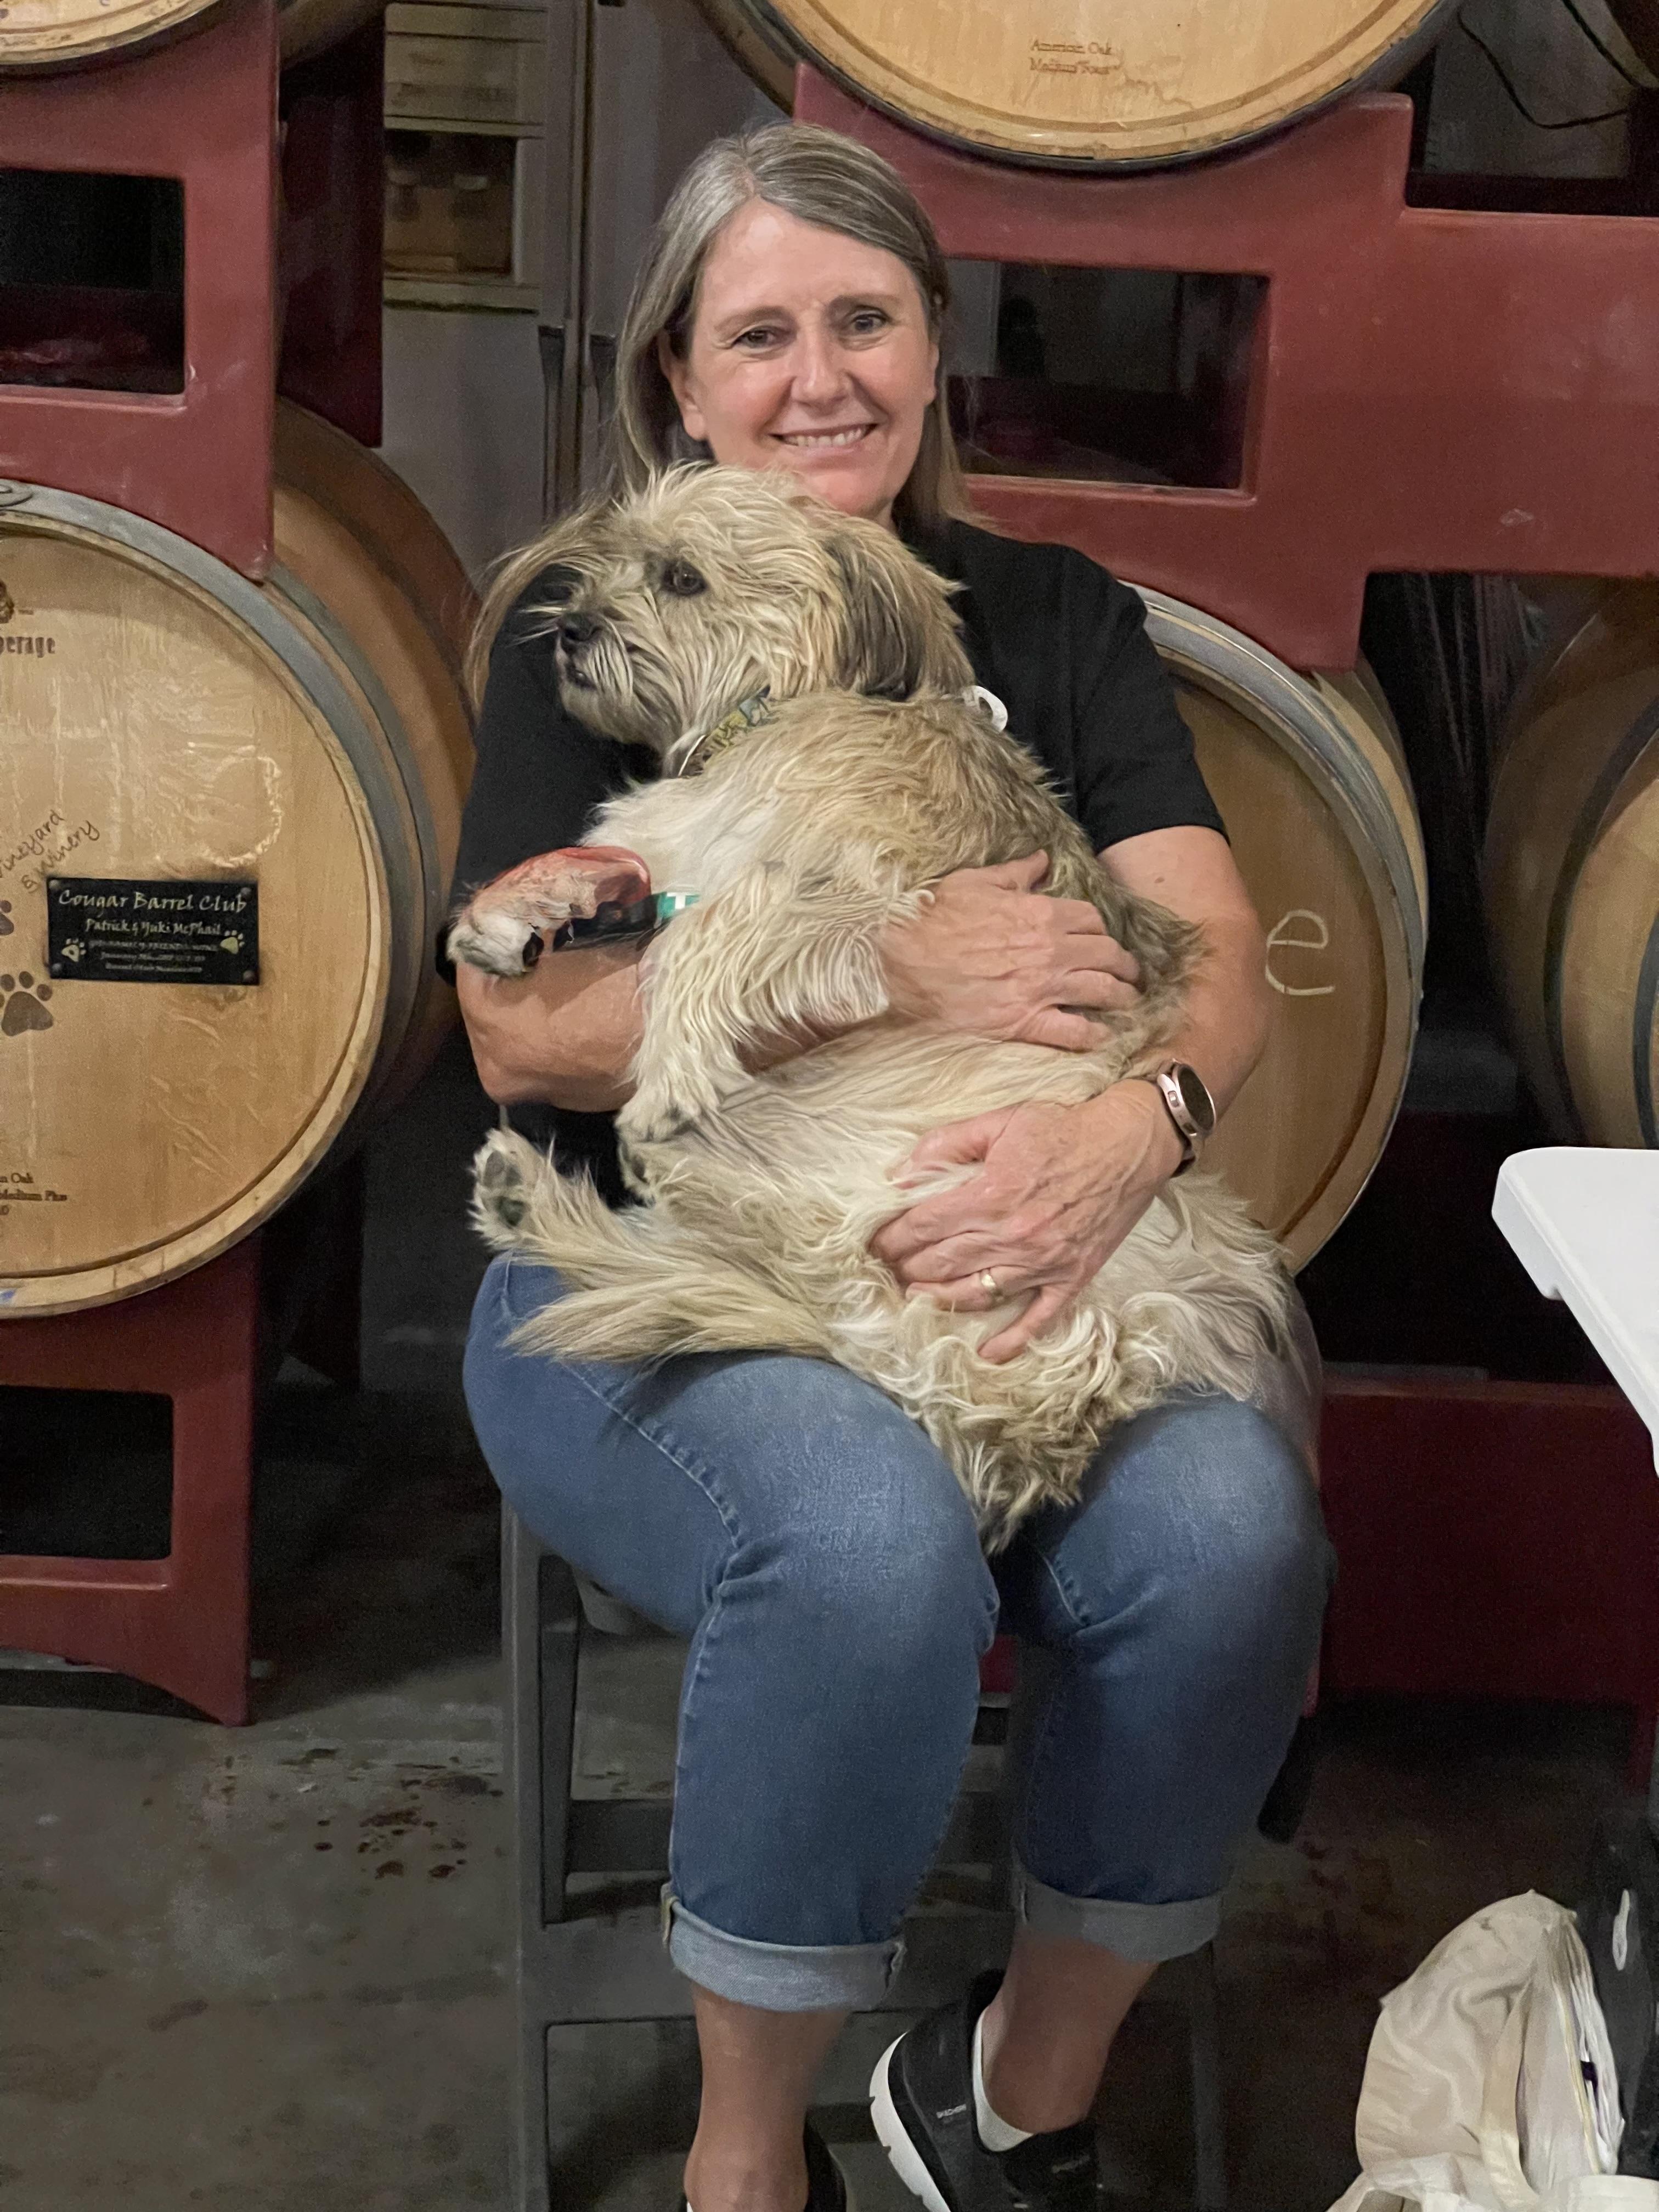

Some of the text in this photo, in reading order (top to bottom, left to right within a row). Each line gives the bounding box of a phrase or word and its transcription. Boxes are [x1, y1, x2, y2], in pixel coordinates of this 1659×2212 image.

[1088, 38, 1111, 55] Oak
[59, 889, 247, 918] Cougar Barrel Club
[85, 918, 131, 932] Patrick
[140, 921, 171, 937] Yuki
[173, 921, 221, 936] McPhail
